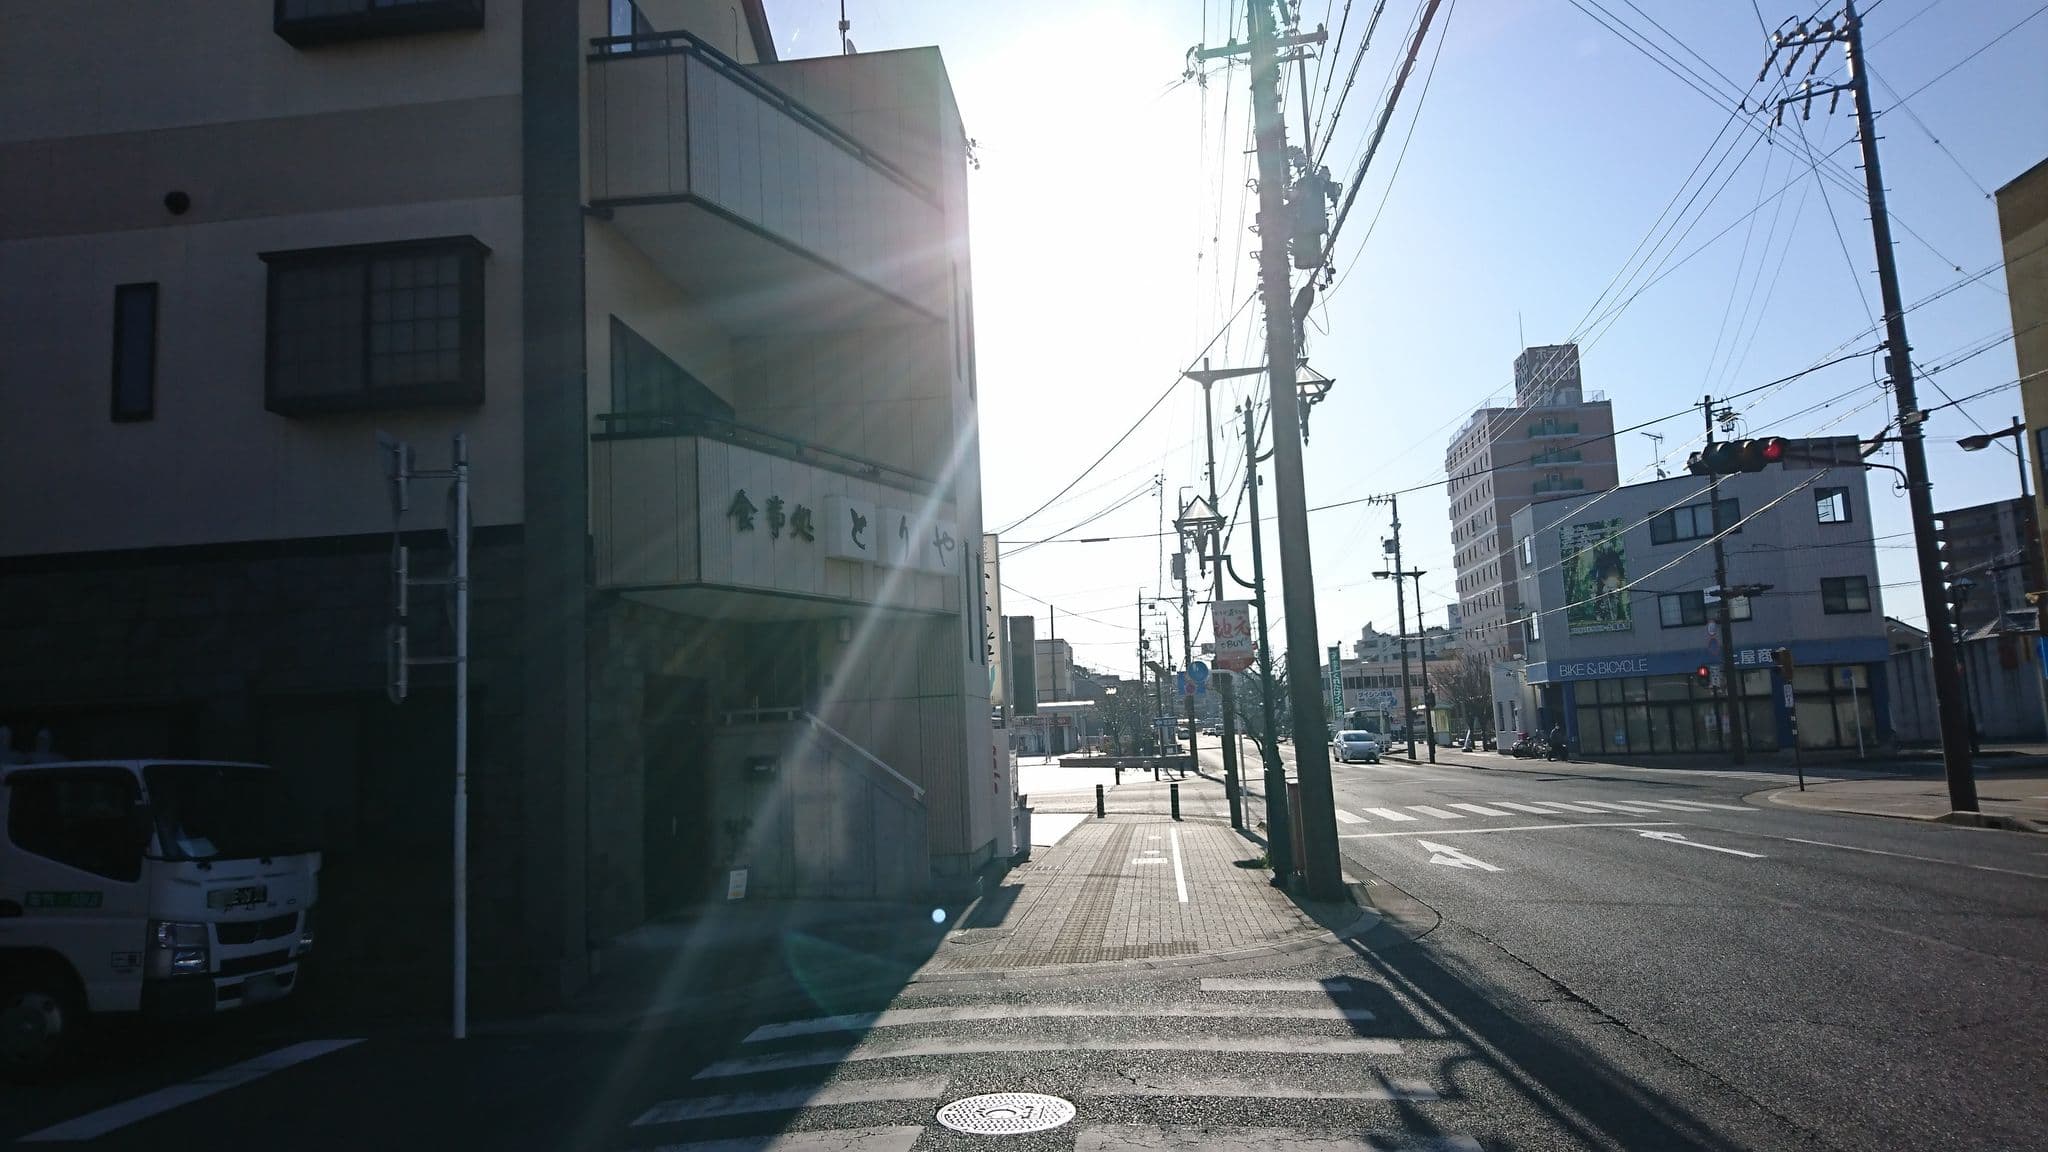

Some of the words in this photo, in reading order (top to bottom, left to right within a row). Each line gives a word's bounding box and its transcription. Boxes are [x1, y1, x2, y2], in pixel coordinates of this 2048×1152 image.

[850, 507, 955, 567] とりや
[1559, 663, 1585, 677] BIKE
[1586, 662, 1597, 675] &
[1598, 658, 1648, 675] BICYCLE
